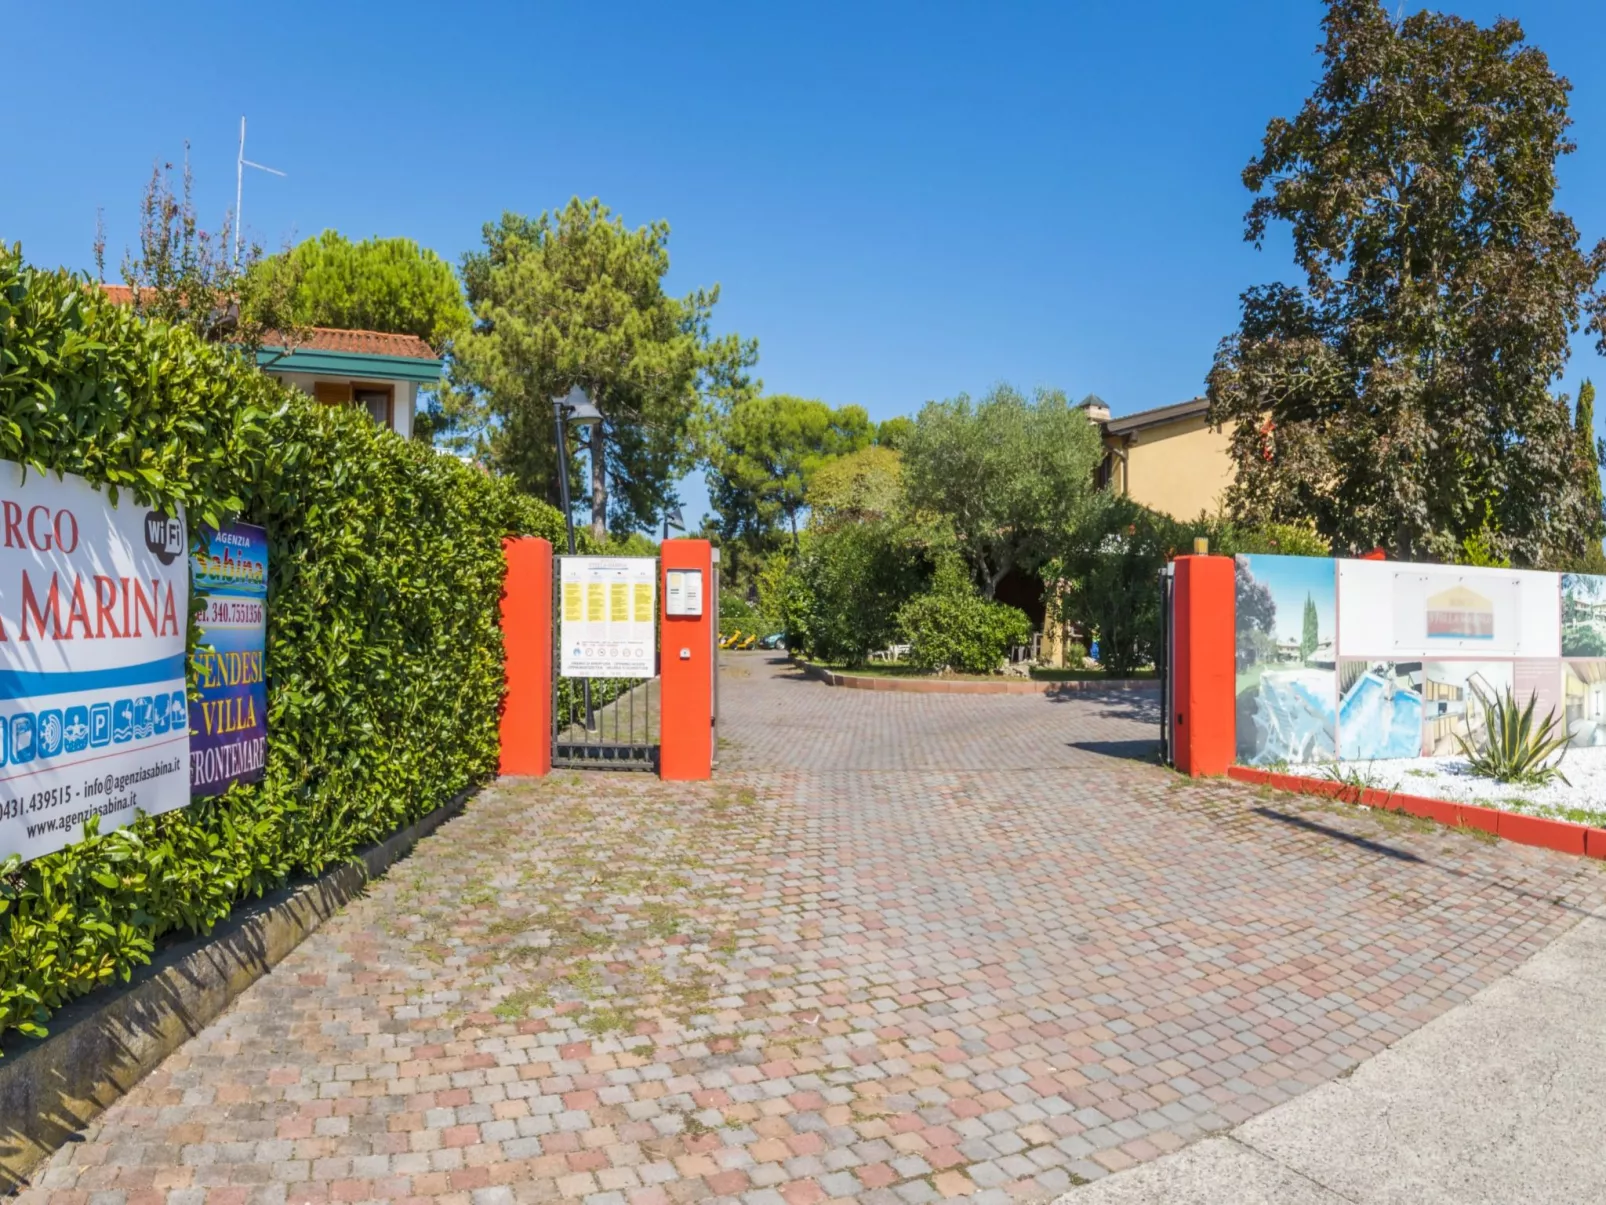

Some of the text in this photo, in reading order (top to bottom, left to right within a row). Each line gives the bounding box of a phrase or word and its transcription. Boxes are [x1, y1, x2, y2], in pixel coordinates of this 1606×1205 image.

[214, 531, 251, 548] AGENZIA
[19, 569, 179, 642] MARINA
[211, 602, 262, 624] 340.7551356
[201, 695, 257, 736] VILLA
[84, 757, 181, 798] info@agenziasabina.it
[27, 791, 138, 839] www.agenziasabina.it
